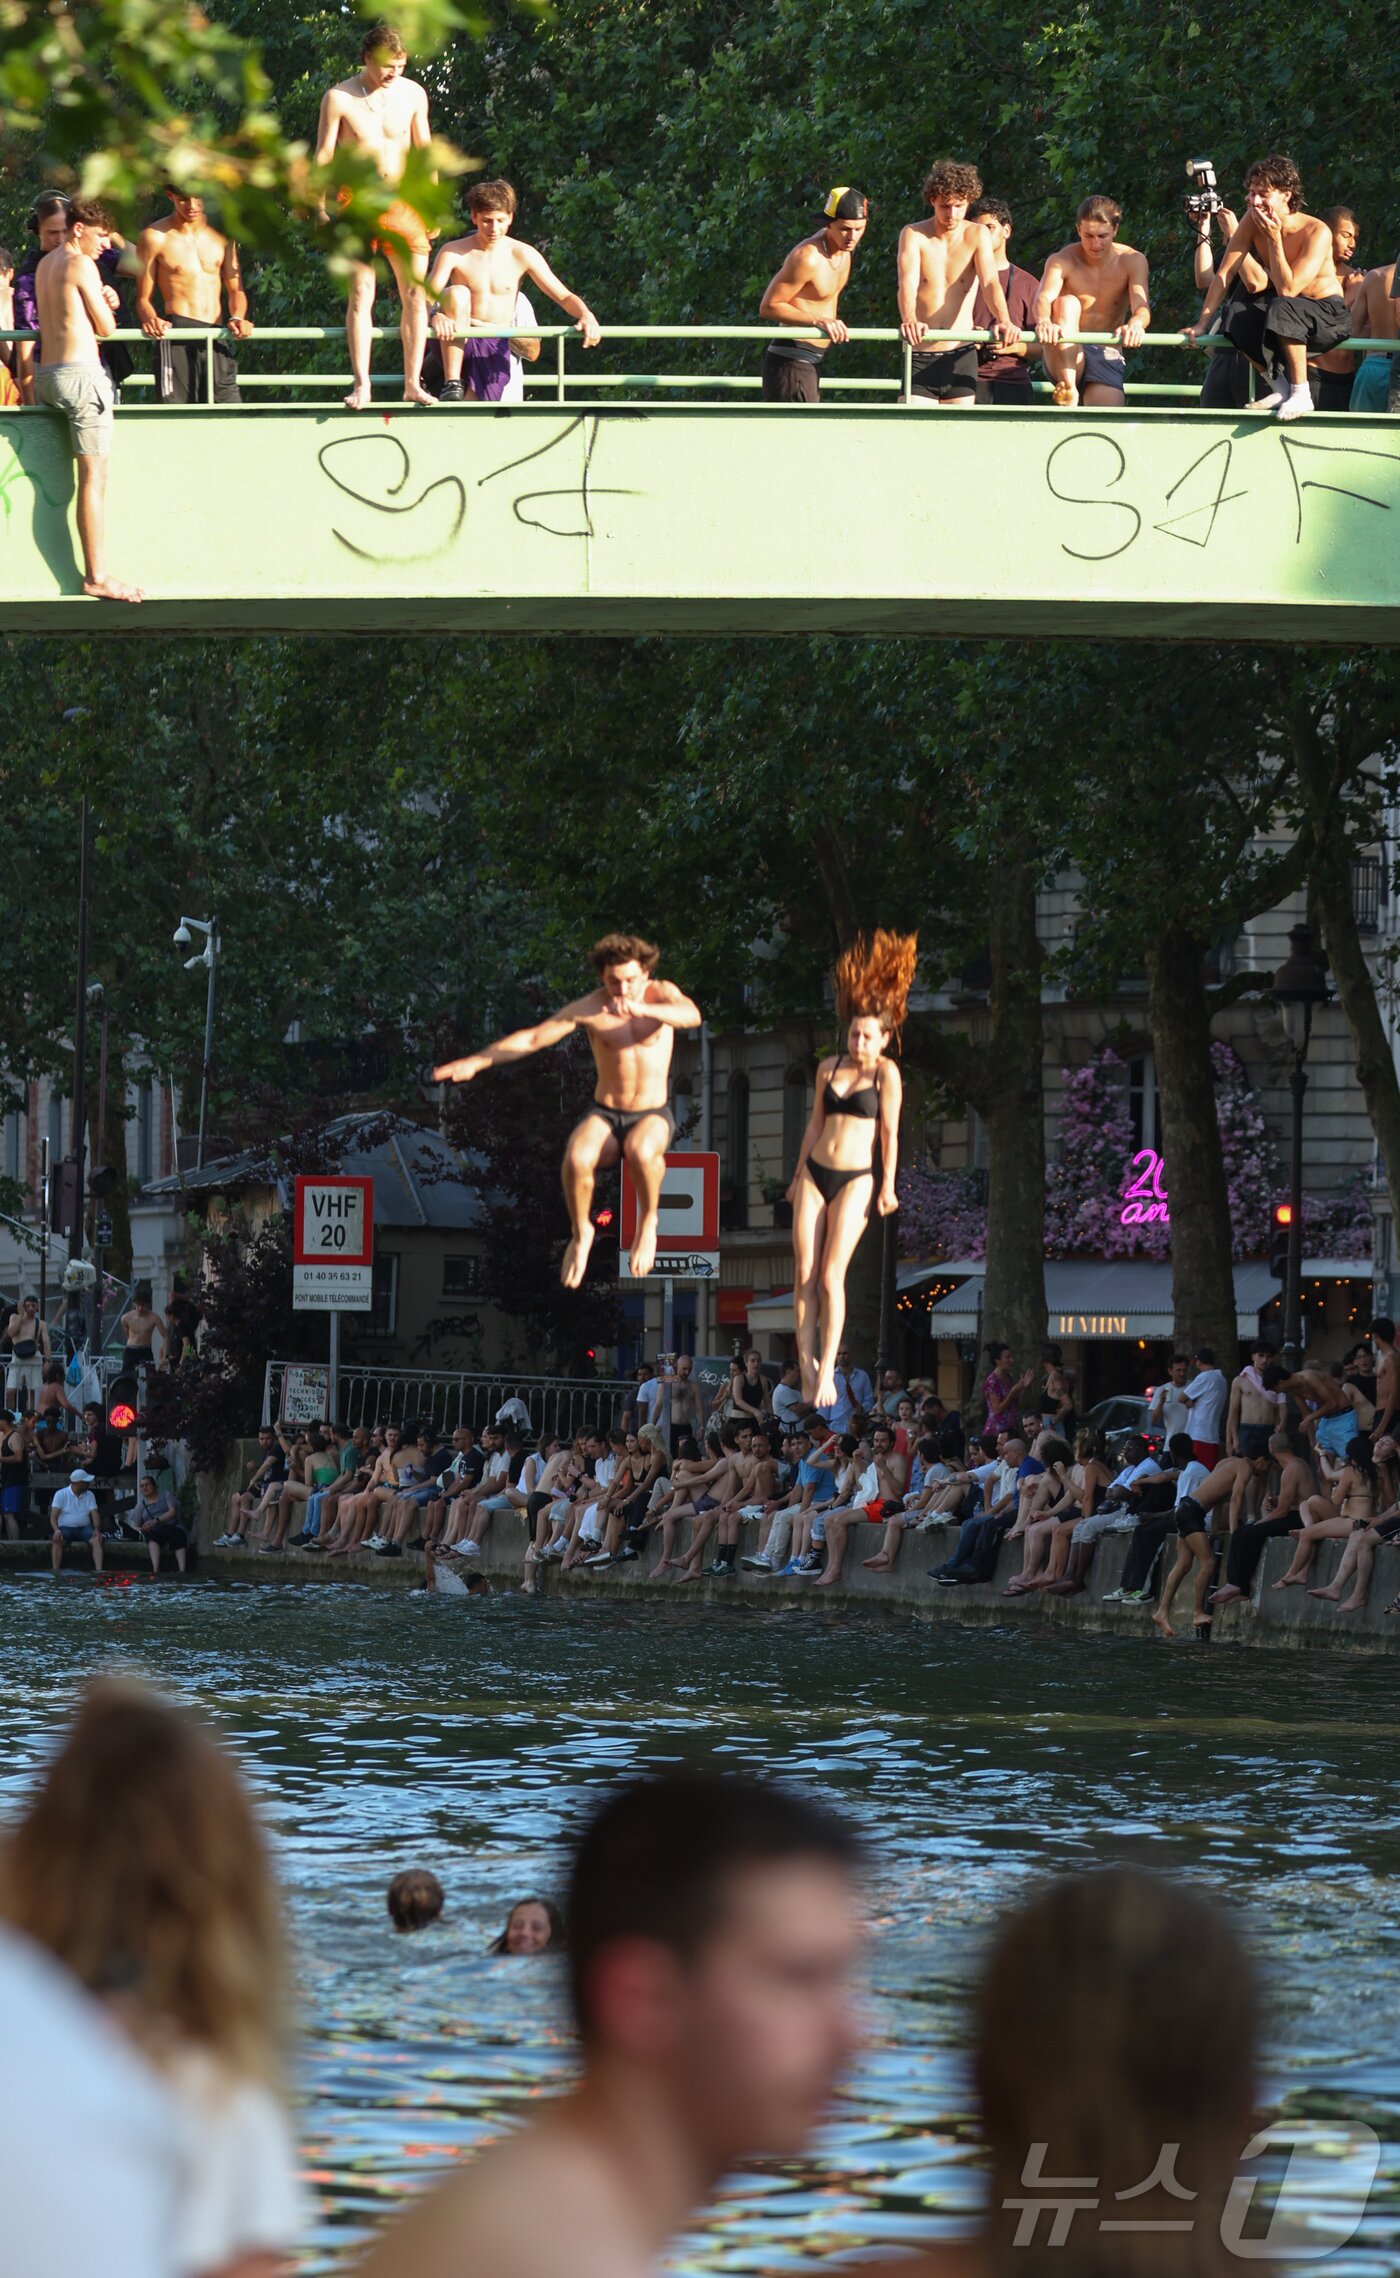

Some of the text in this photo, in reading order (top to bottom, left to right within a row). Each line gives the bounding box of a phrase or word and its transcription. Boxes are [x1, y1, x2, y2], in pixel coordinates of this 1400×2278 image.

[312, 1194, 357, 1217] VHF
[321, 1224, 346, 1248] 20
[303, 1272, 361, 1280] 01 40 35 63 21
[295, 1293, 369, 1304] PONT MOBILE TÉLÉCOMMANDÉ
